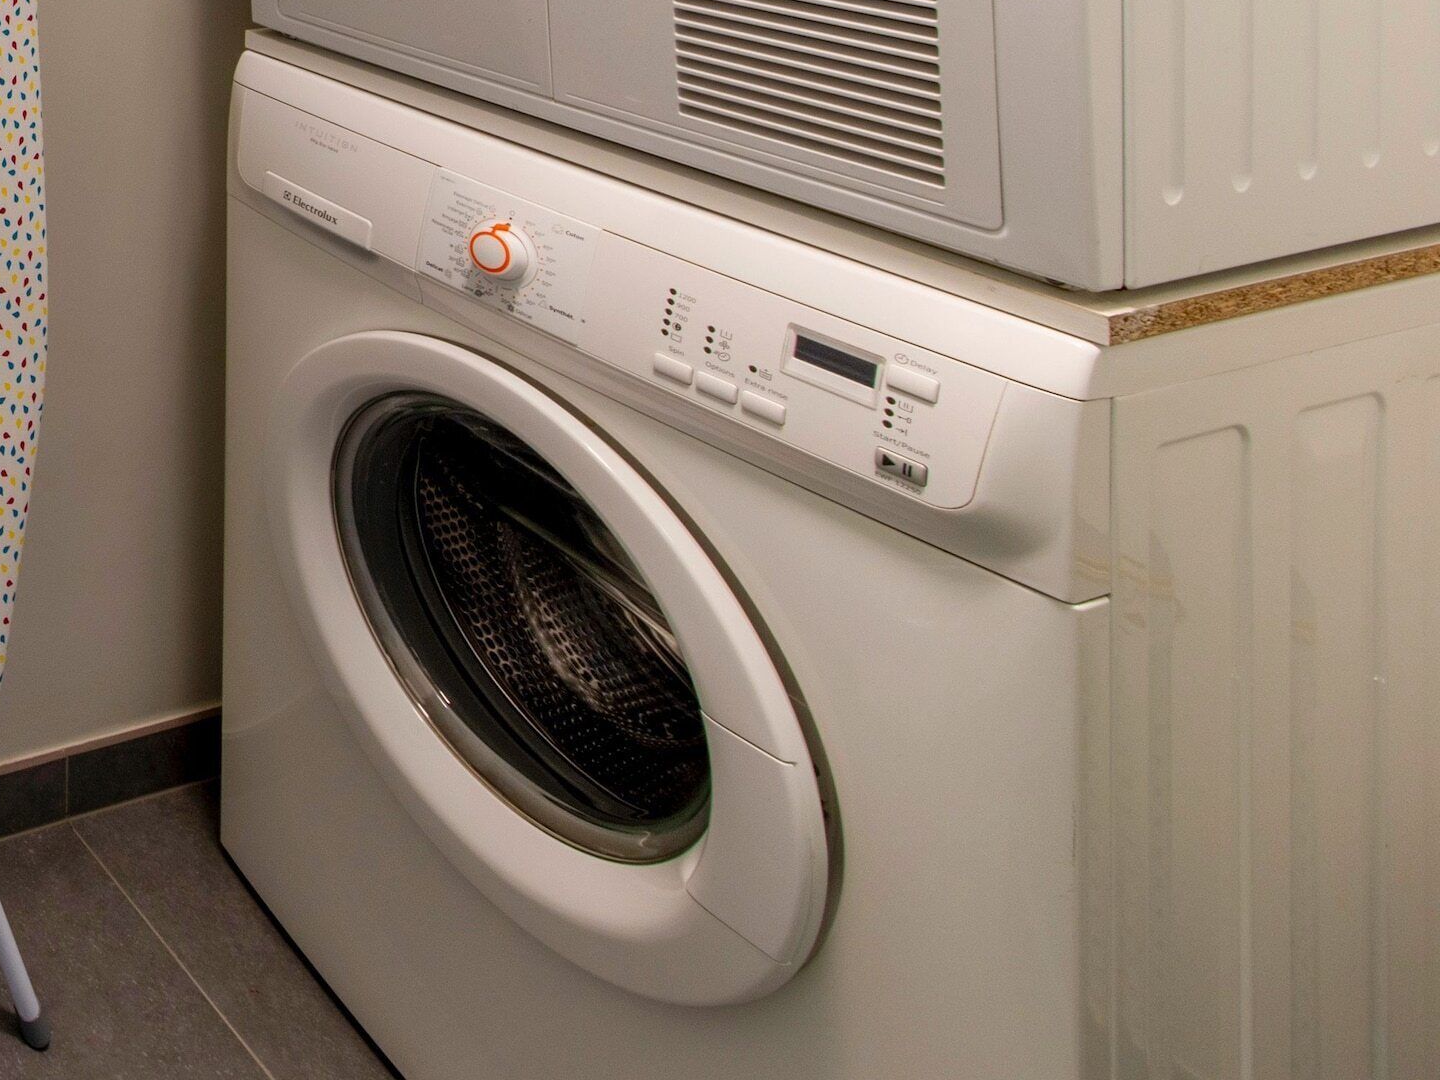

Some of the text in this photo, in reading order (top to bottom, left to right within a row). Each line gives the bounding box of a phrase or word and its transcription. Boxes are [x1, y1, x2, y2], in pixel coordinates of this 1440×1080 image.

[295, 120, 359, 152] INTUITION
[293, 195, 338, 225] Electrolux
[678, 293, 697, 304] 1200
[676, 302, 690, 312] 900
[674, 312, 688, 322] 700
[668, 345, 685, 357] Spin
[705, 361, 736, 378] Options
[910, 360, 938, 375] Delay
[744, 378, 788, 400] Extra rinse
[873, 430, 930, 459] Start/Pause
